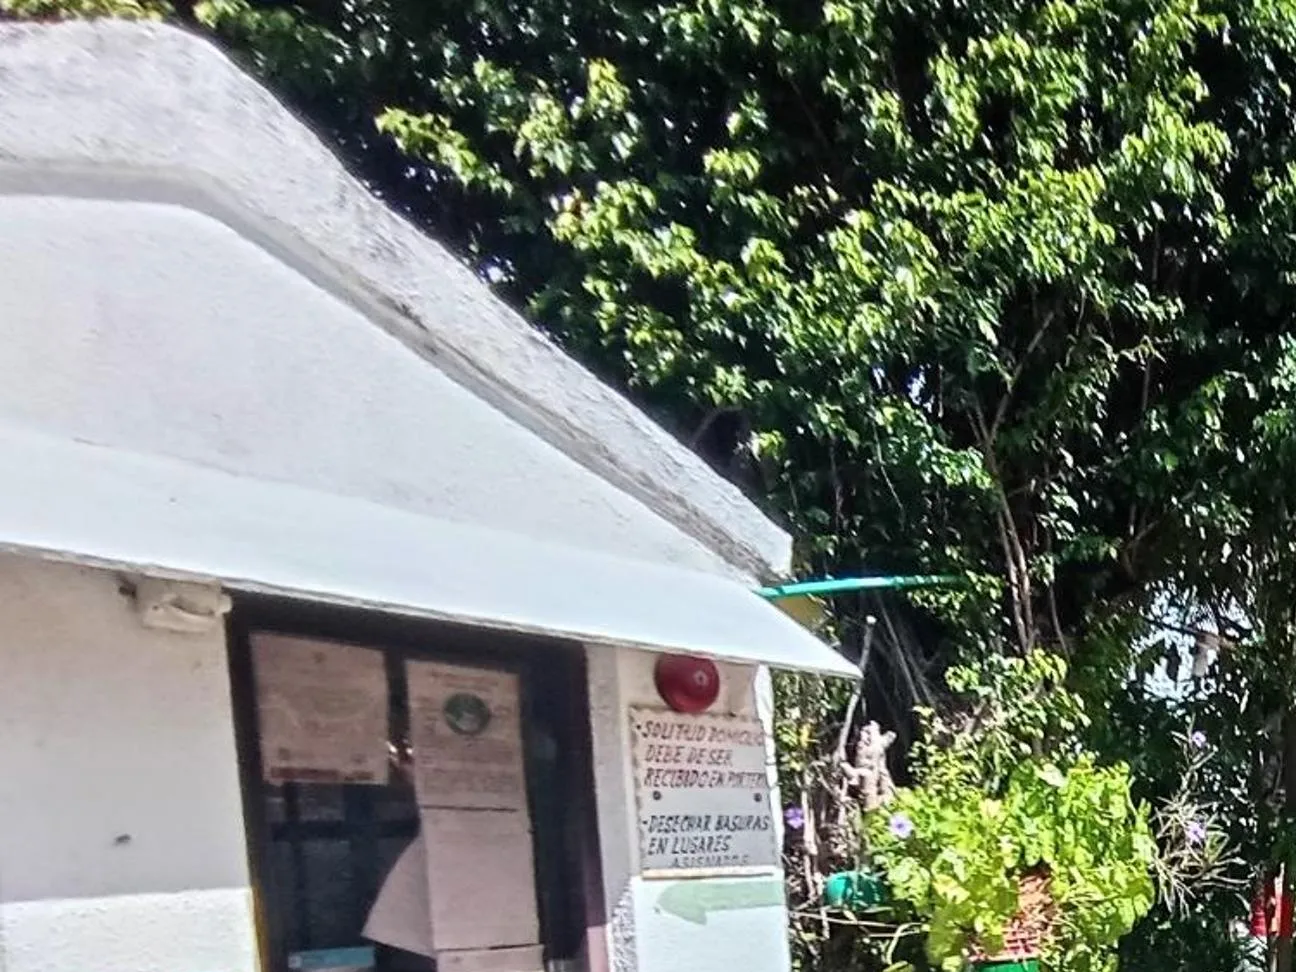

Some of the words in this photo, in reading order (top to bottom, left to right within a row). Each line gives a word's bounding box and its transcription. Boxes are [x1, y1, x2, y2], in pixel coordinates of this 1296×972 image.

[644, 744, 685, 763] DEBE
[686, 747, 706, 764] DE
[707, 749, 732, 766] SER
[714, 815, 770, 832] BASURAS
[647, 836, 668, 855] EN
